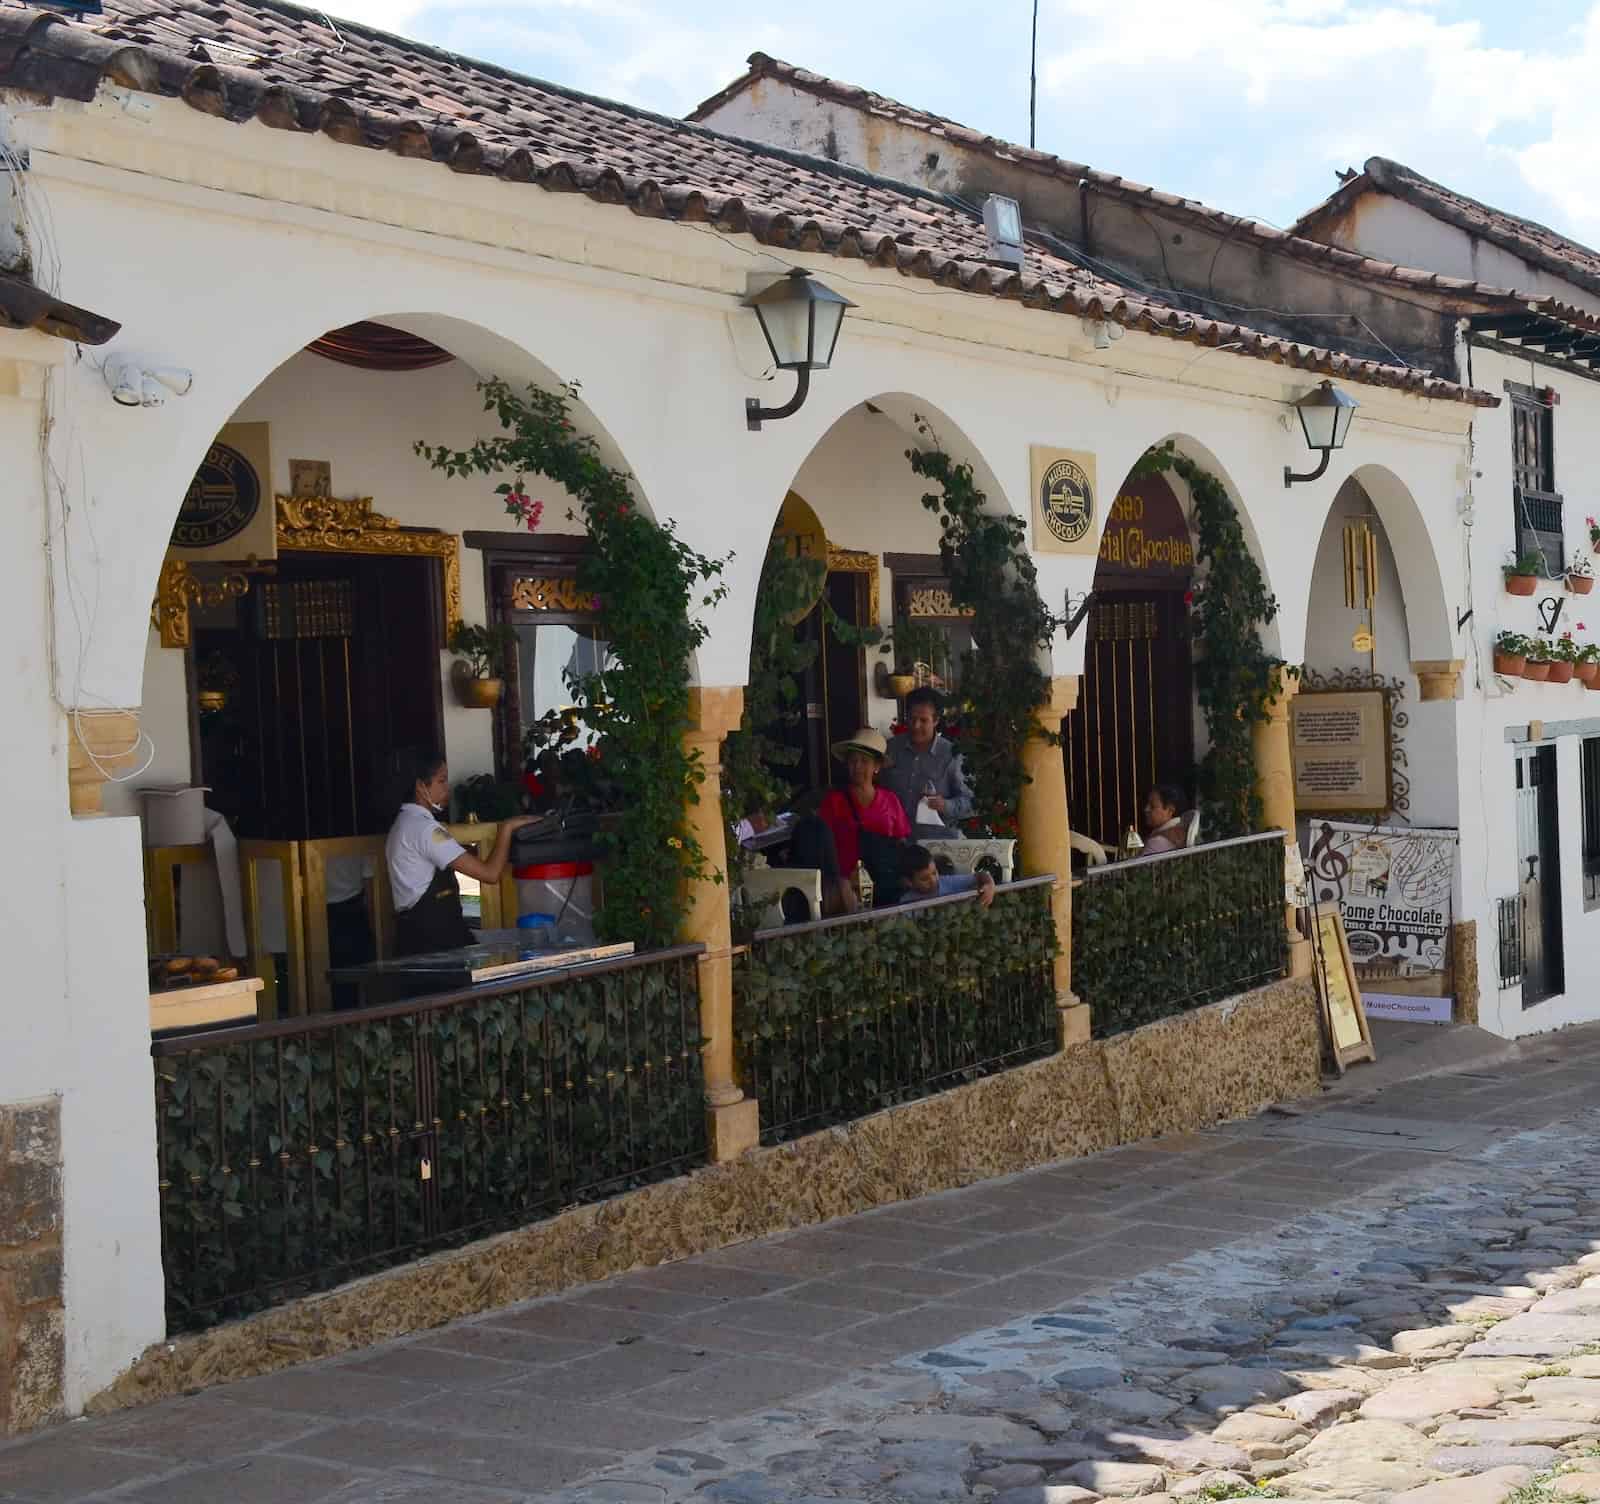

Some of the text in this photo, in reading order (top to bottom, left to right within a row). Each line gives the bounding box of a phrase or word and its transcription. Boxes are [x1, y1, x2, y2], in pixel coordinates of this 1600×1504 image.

[1047, 463, 1072, 487] MUSEO
[1047, 509, 1088, 539] CHOCOLATE
[1127, 527, 1194, 568] Chocolate
[1339, 900, 1443, 925] Come Chocolate
[1368, 921, 1382, 930] de
[1386, 921, 1396, 931] la
